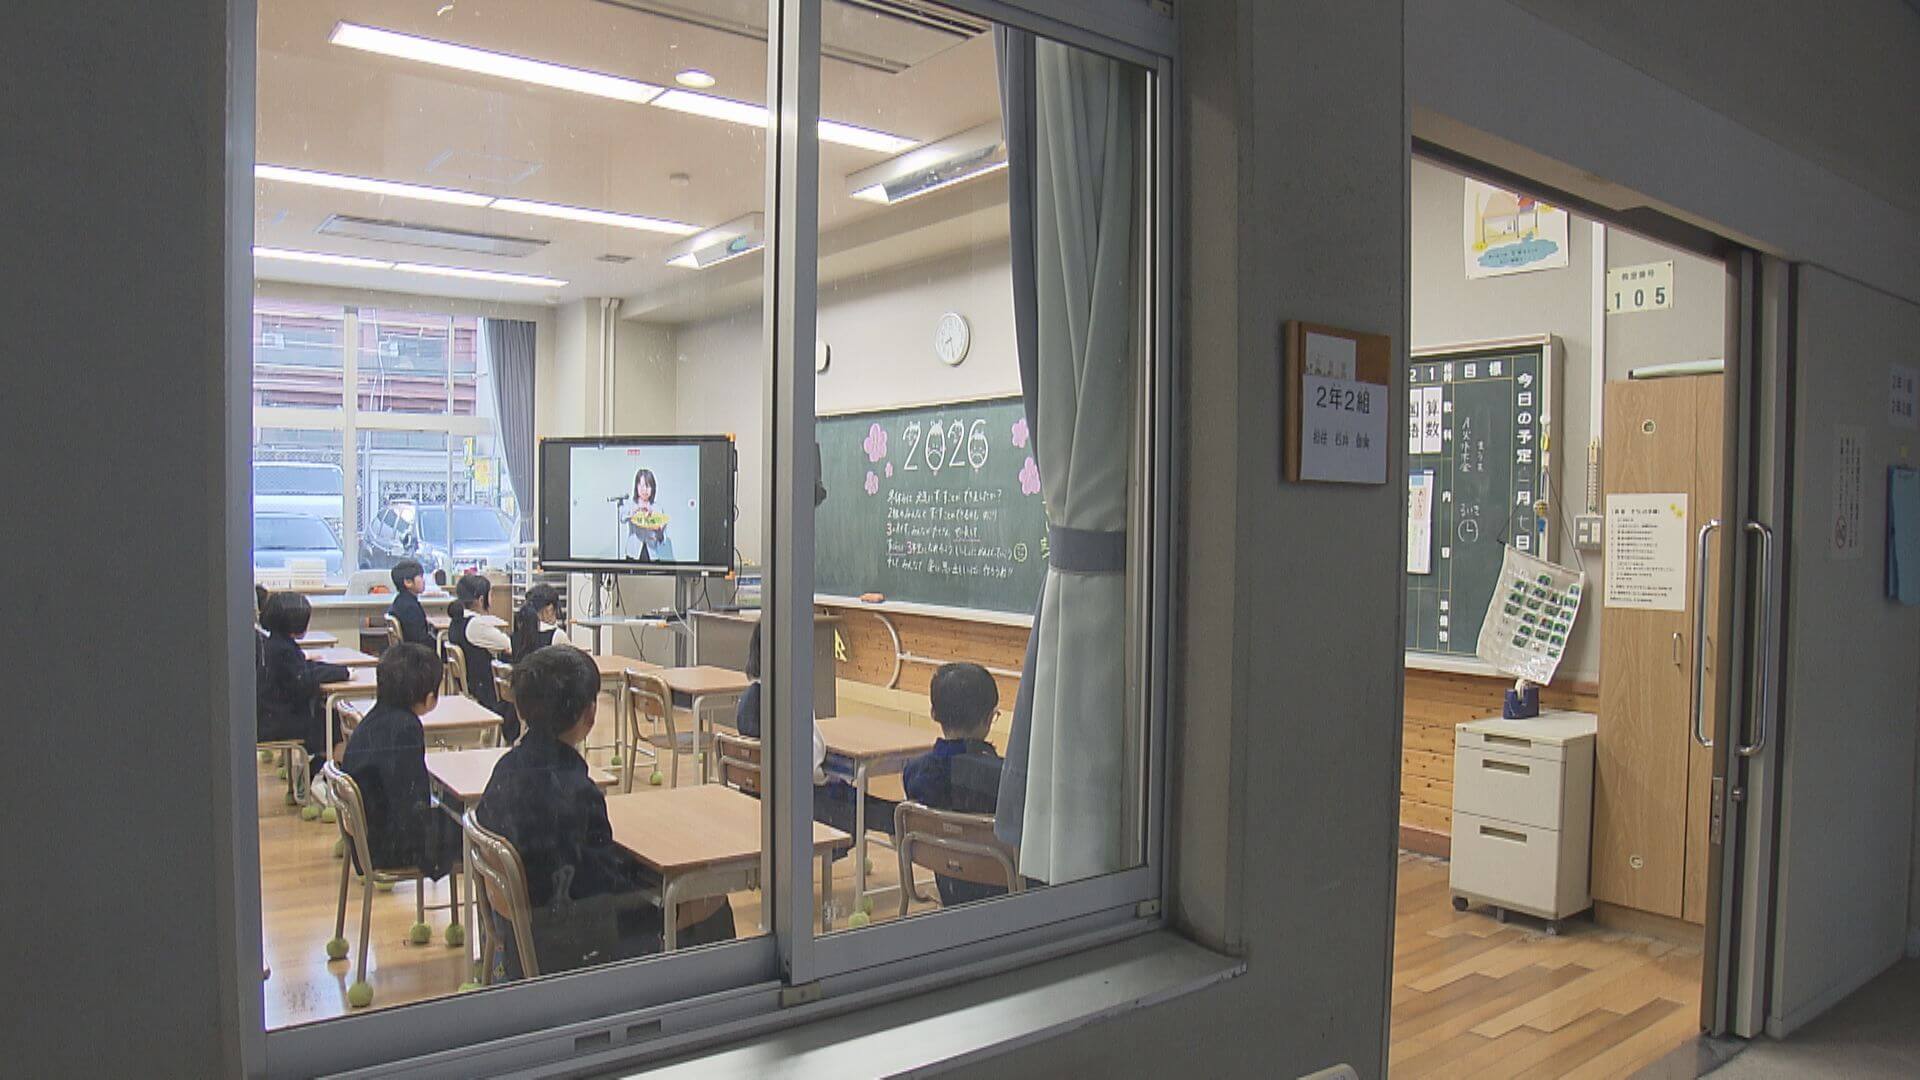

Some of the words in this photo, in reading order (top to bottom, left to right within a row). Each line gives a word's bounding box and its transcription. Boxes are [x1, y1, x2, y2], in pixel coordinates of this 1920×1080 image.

[1615, 287, 1665, 309] 105
[1316, 383, 1370, 414] 2年2組
[1516, 373, 1533, 464] 今日の予定
[902, 418, 989, 472] 2026
